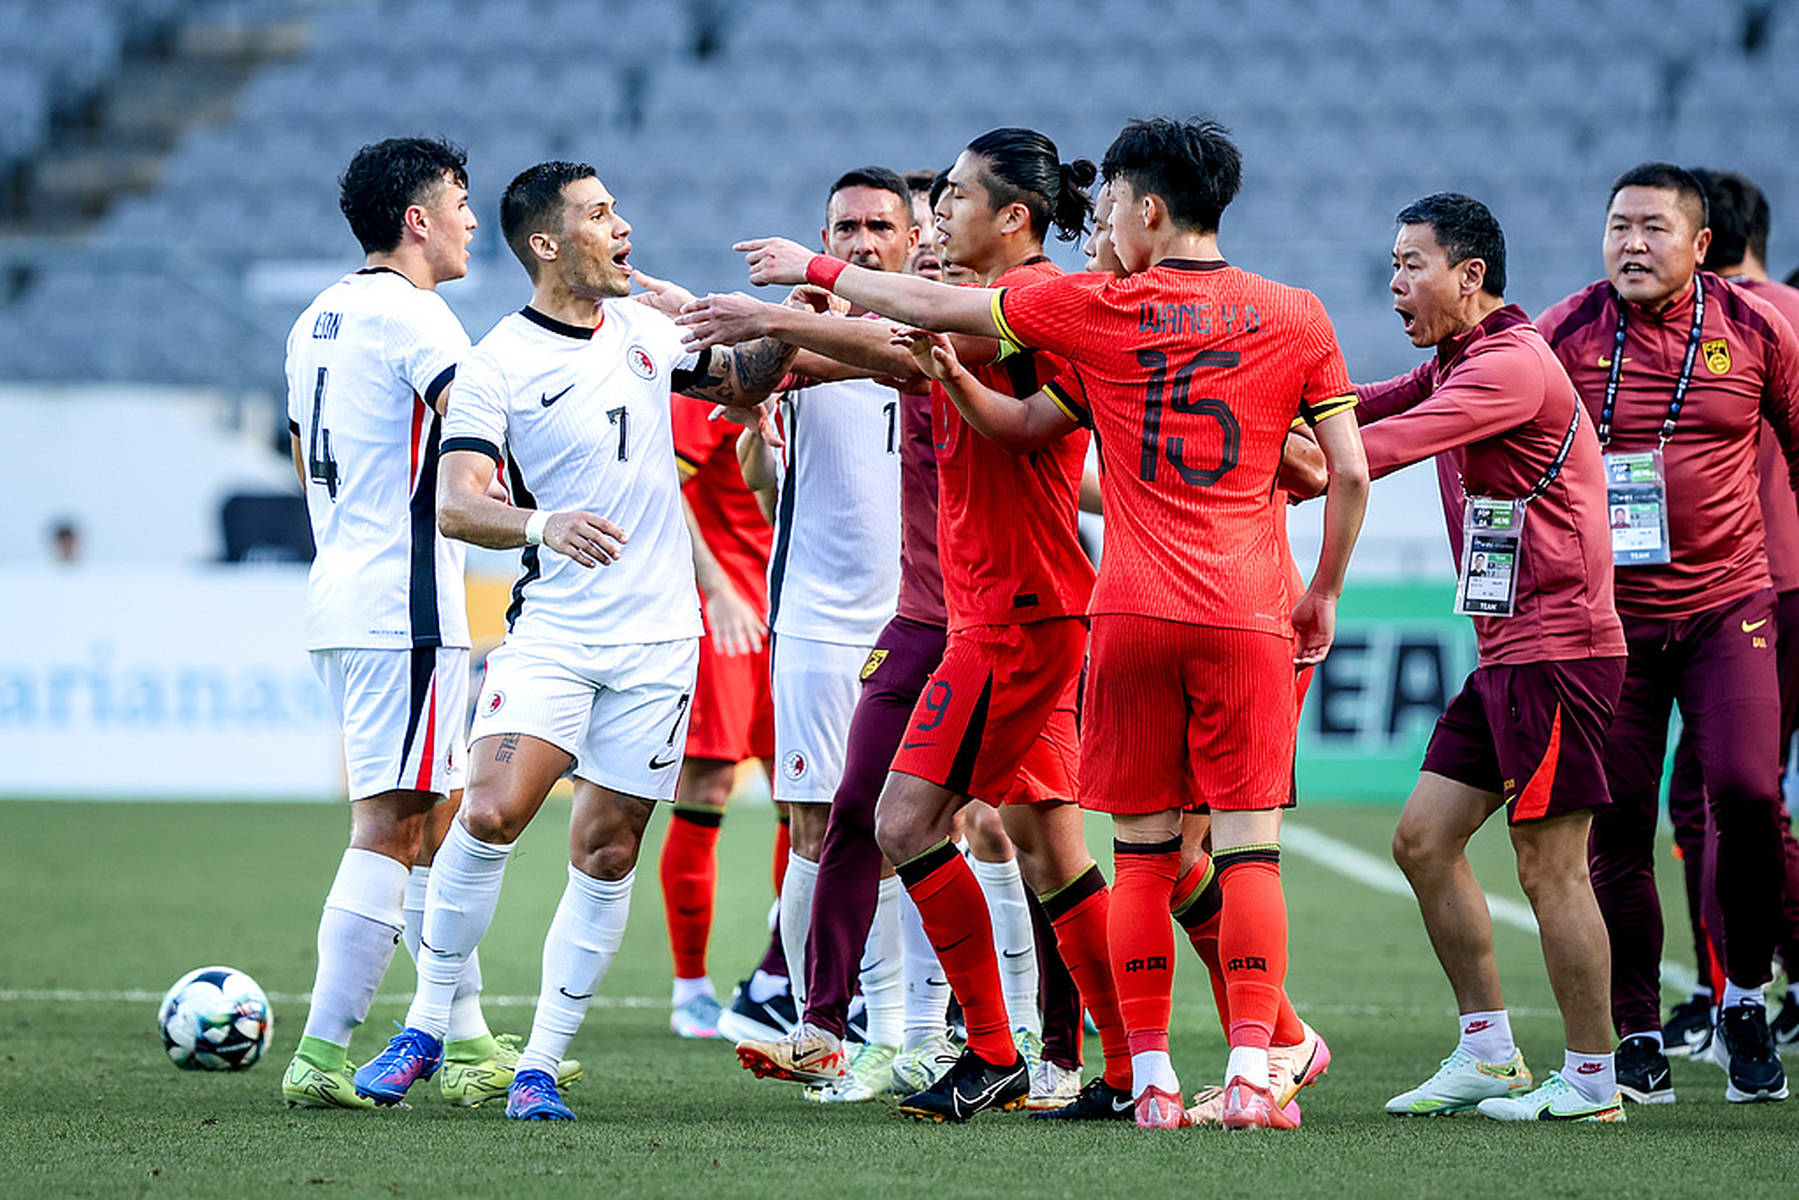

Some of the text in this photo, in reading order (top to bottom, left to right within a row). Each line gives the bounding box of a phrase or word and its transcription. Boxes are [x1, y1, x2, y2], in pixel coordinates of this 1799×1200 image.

[312, 311, 344, 341] LEON
[1138, 302, 1210, 334] WANG
[309, 366, 342, 503] 4
[605, 405, 629, 462] 7
[882, 401, 901, 455] 1
[1136, 349, 1241, 487] 15
[667, 693, 690, 747] 7
[917, 680, 953, 732] 9
[1125, 956, 1167, 972] 中国
[1227, 956, 1267, 972] 中国
